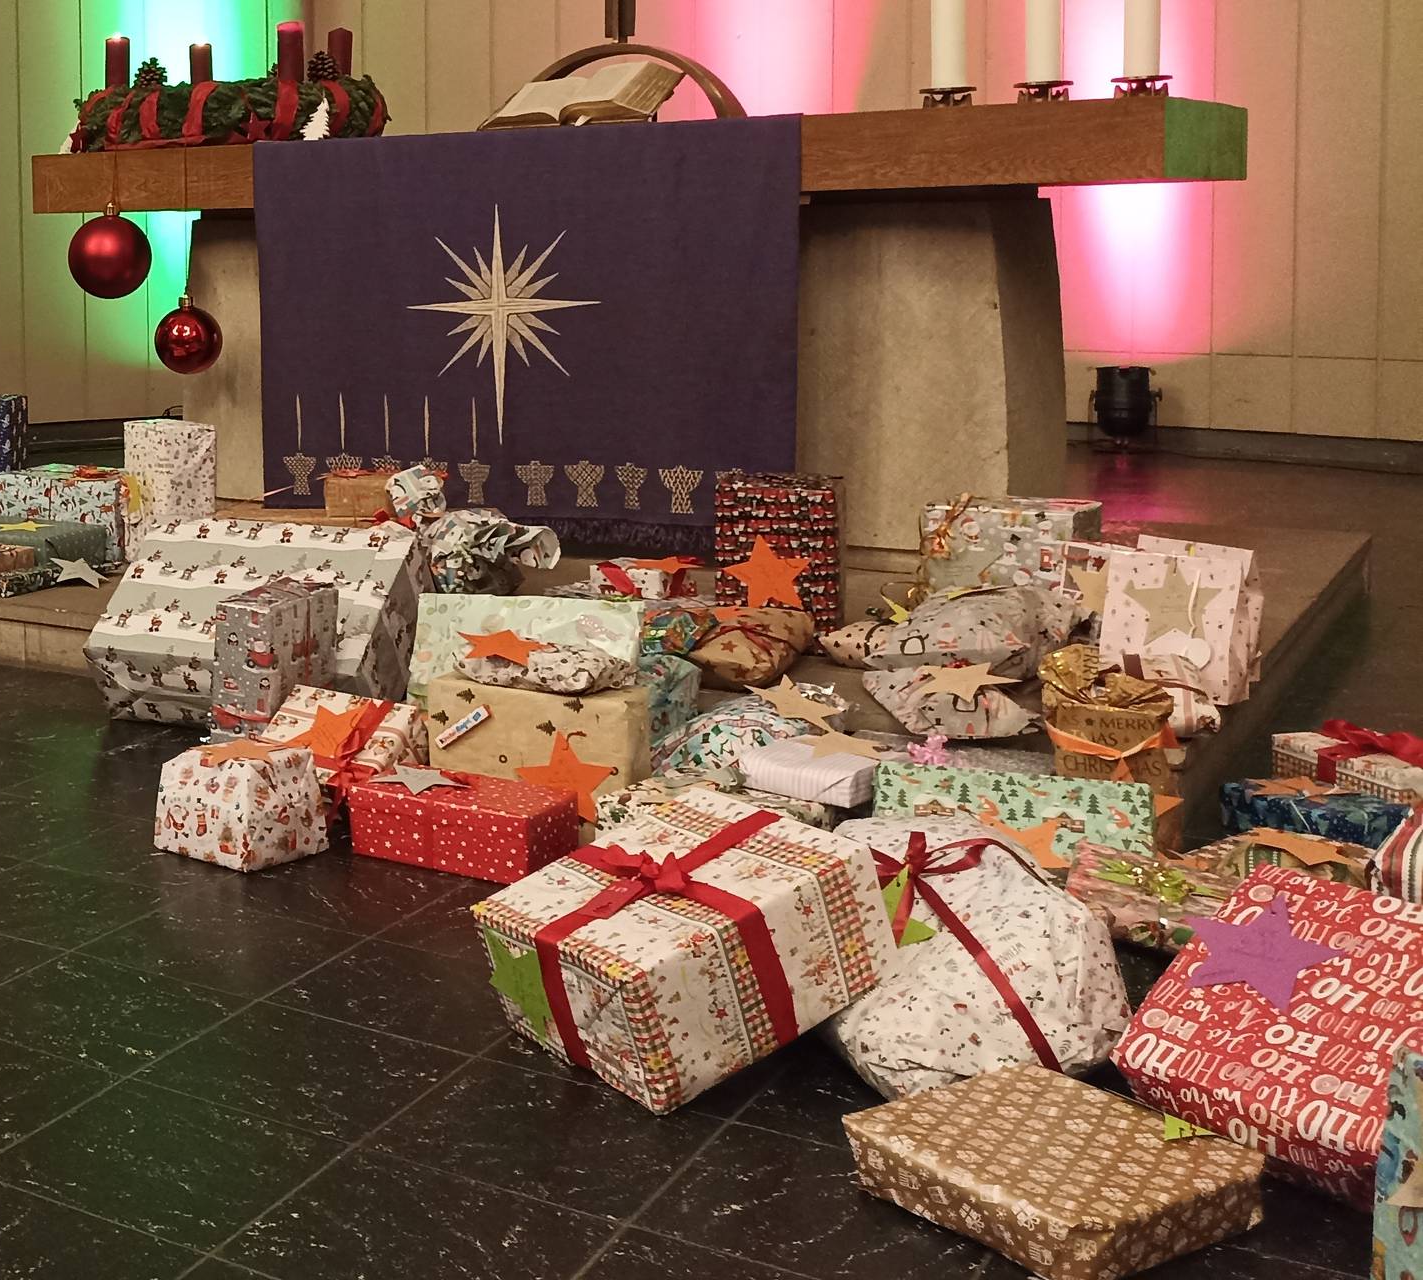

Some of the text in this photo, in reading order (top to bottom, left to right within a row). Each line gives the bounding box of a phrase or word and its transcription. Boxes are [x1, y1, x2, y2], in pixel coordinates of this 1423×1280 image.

[1099, 717, 1157, 731] MERRY
[1063, 754, 1162, 777] CHRISAS
[1328, 931, 1376, 959] HO
[1360, 918, 1421, 951] HO
[1152, 978, 1189, 1009] HO
[1310, 977, 1369, 1014] HO
[1353, 967, 1401, 997] HO
[1142, 1008, 1200, 1041] HO
[1265, 1024, 1329, 1058] HO
[1125, 1033, 1187, 1082] HO
[1178, 1049, 1223, 1087] HO
[1251, 1048, 1312, 1084] HO
[1320, 1043, 1364, 1075] HO
[1219, 1062, 1266, 1091] HO
[1310, 1074, 1374, 1107] HO
[1228, 1118, 1277, 1157] HO
[1249, 1103, 1294, 1142] HO
[1297, 1100, 1362, 1156] HO
